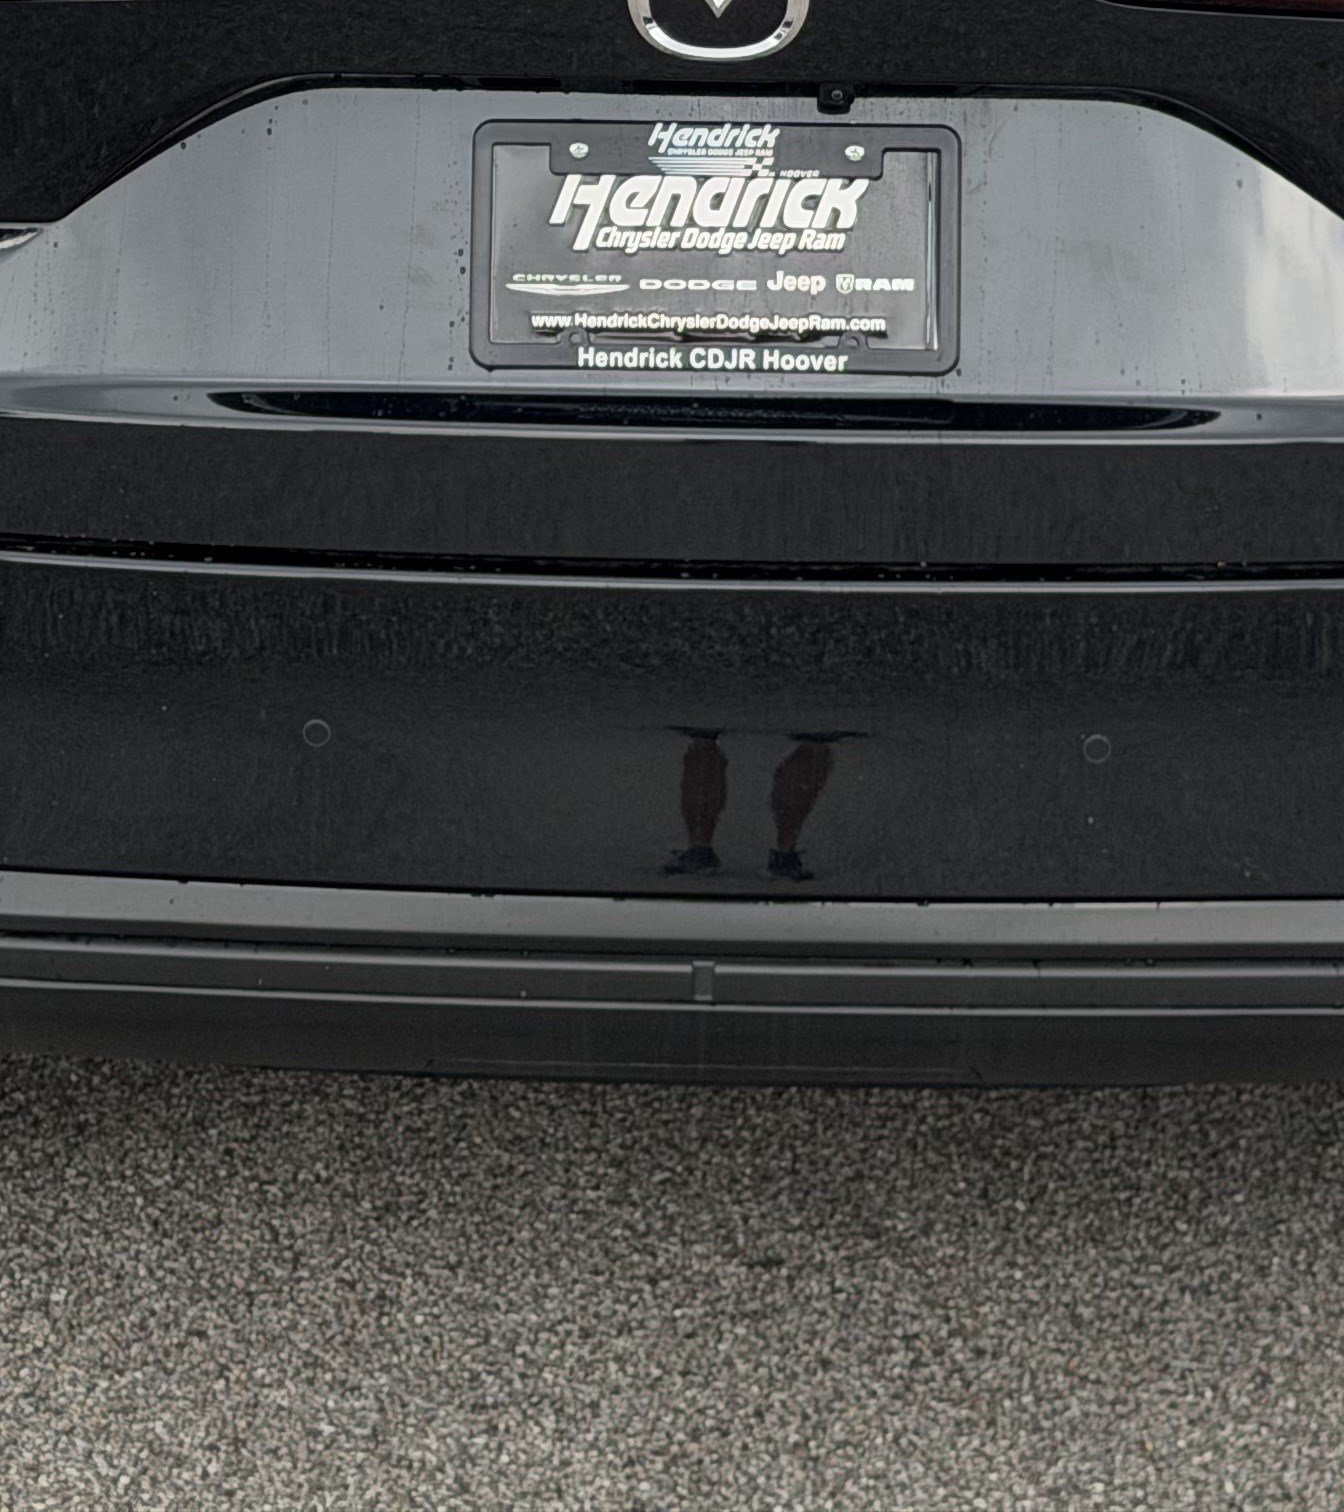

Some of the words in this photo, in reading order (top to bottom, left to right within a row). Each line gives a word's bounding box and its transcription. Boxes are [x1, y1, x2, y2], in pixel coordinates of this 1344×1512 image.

[647, 122, 780, 154] Hendrick
[549, 174, 869, 251] Hendrick
[596, 226, 680, 254] Chrysler
[681, 227, 747, 255] Dodge
[747, 228, 797, 255] Jeep
[798, 230, 846, 250] Ram
[512, 273, 622, 282] CHRYSLER
[640, 279, 757, 291] DODGE
[767, 270, 826, 295] Jeep
[855, 278, 915, 291] RAM
[531, 312, 886, 332] www.HendrickChryslerDodgeJeepRam.com
[578, 346, 683, 369] Hendrick
[689, 348, 756, 370] CDJR
[762, 349, 849, 372] Hoover
